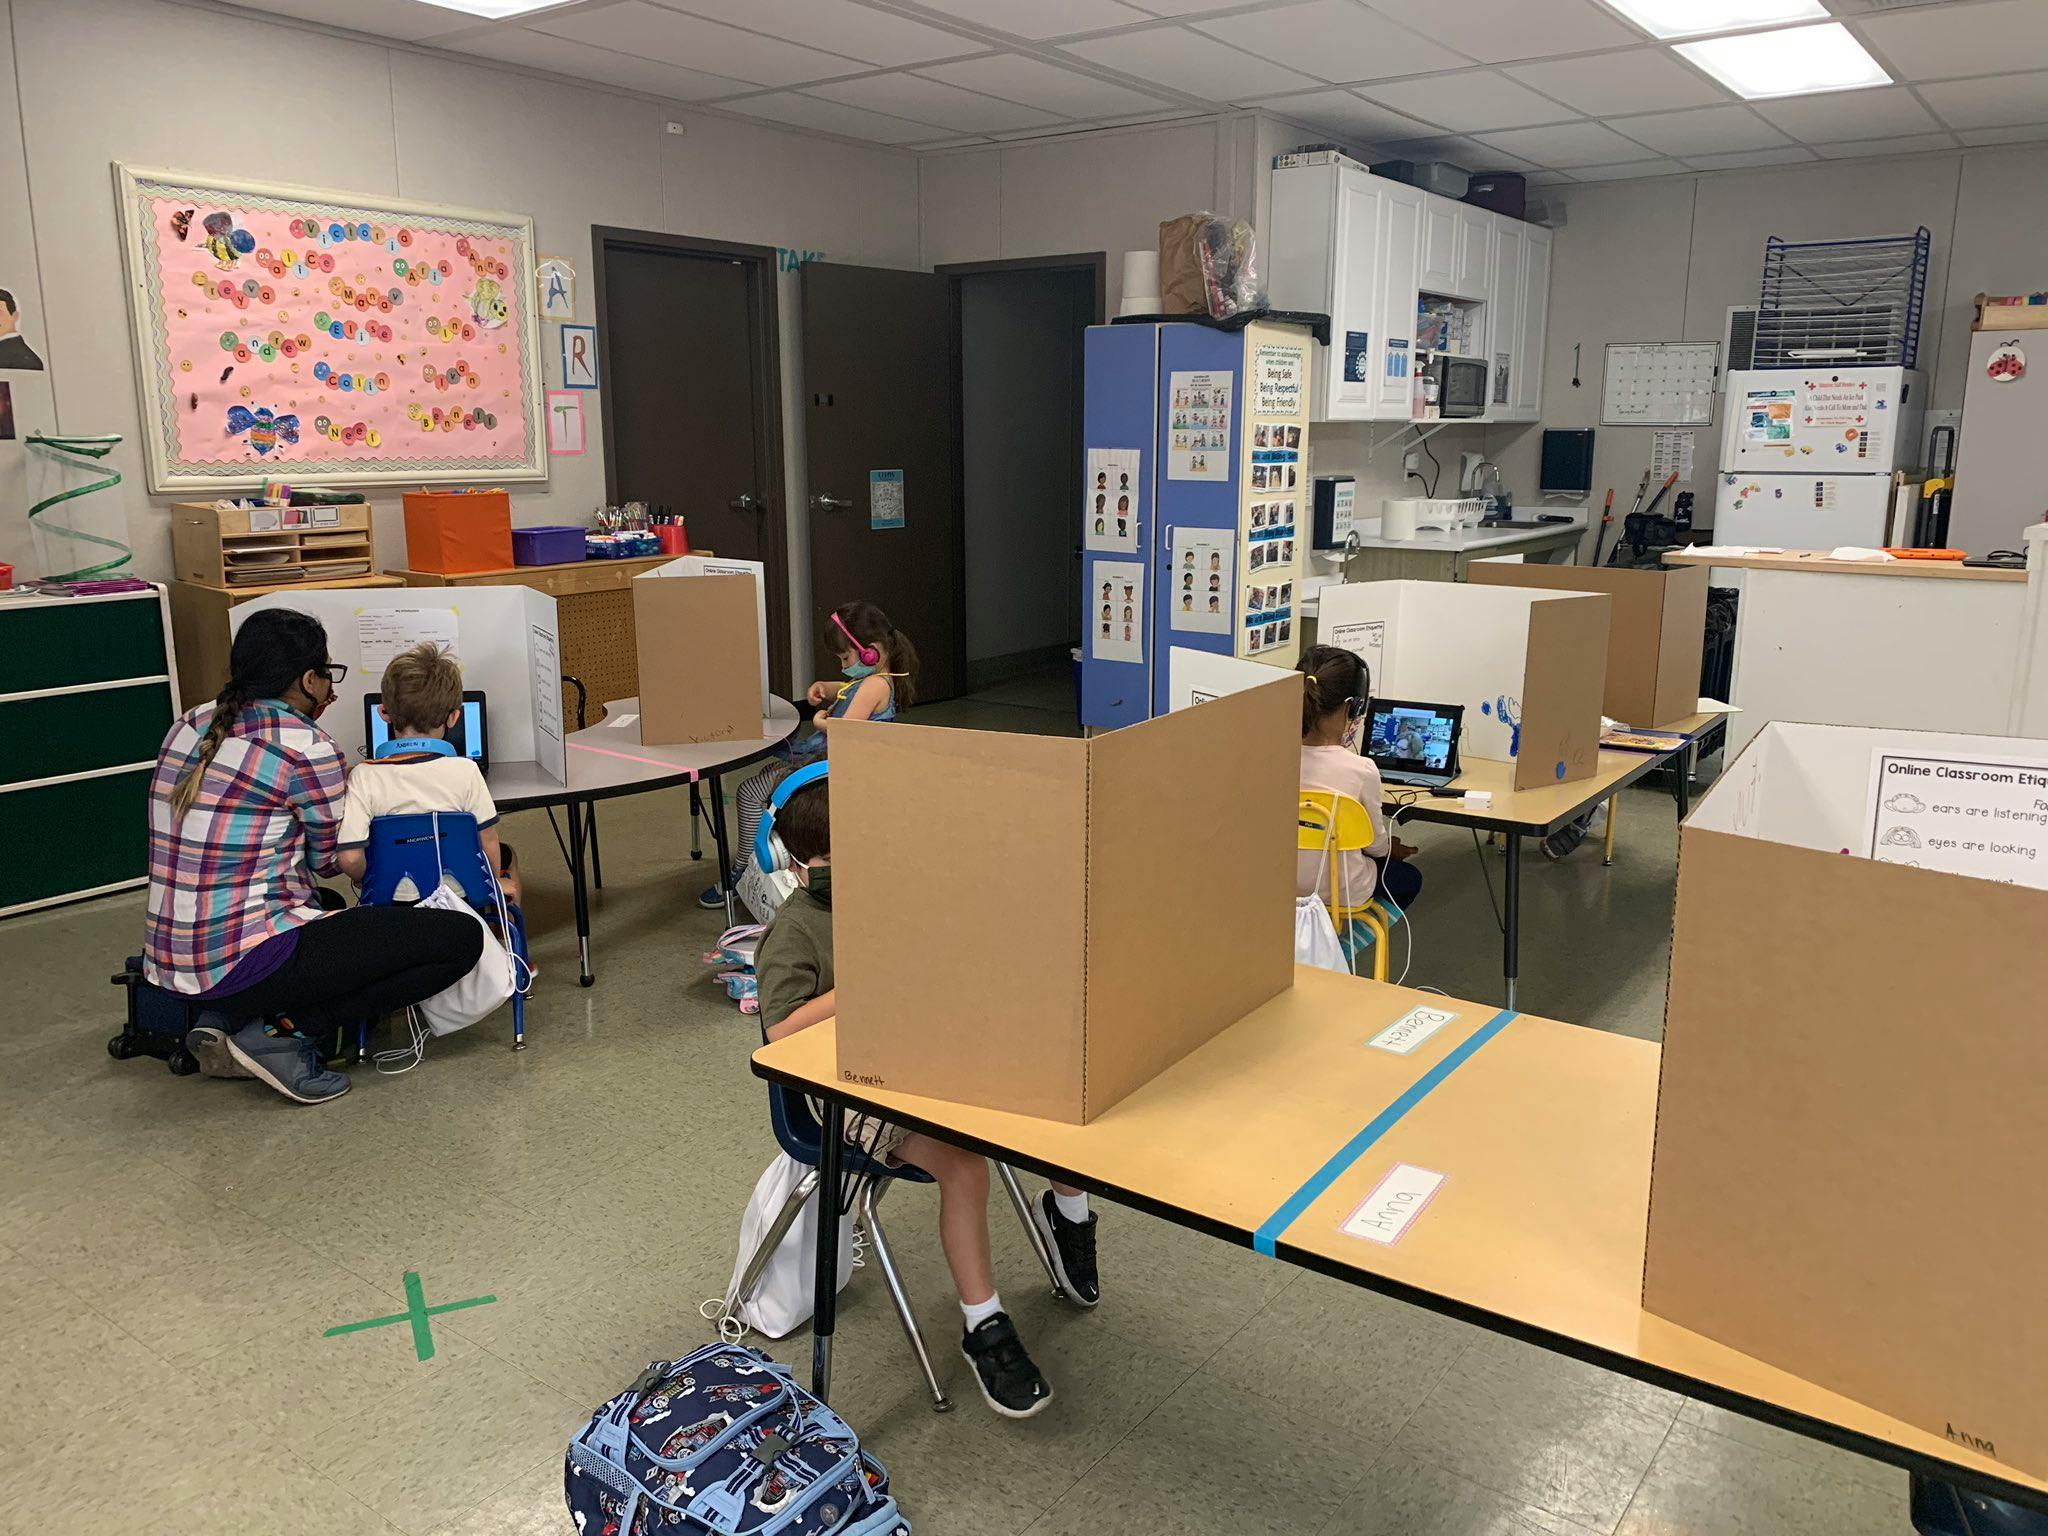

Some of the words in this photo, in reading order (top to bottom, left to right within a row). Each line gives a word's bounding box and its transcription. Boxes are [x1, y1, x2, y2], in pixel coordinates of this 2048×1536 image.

[307, 223, 408, 252] Victoria
[408, 264, 448, 282] Aria
[468, 253, 505, 276] Anna
[343, 290, 399, 309] Manav
[334, 324, 389, 342] Elise
[237, 337, 307, 358] andrew
[328, 376, 385, 391] Colin
[1267, 368, 1281, 381] Being
[1282, 369, 1293, 379] Safe
[1260, 382, 1273, 395] Being
[1275, 382, 1299, 395] Respectful
[1262, 396, 1275, 409] Being
[1277, 396, 1296, 409] Friendly
[331, 428, 375, 443] Neel
[1888, 763, 1931, 776] Online
[1936, 767, 2013, 783] Classroom
[2019, 773, 2048, 788] Etiq
[1932, 804, 1961, 814] ears
[1965, 807, 1989, 817] are
[1994, 807, 2048, 825] listening
[1928, 838, 1957, 849] eyes
[1962, 841, 1985, 851] are
[1990, 842, 2036, 859] looking
[1361, 1191, 1422, 1231] Anna
[1945, 1422, 1996, 1456] Anna
